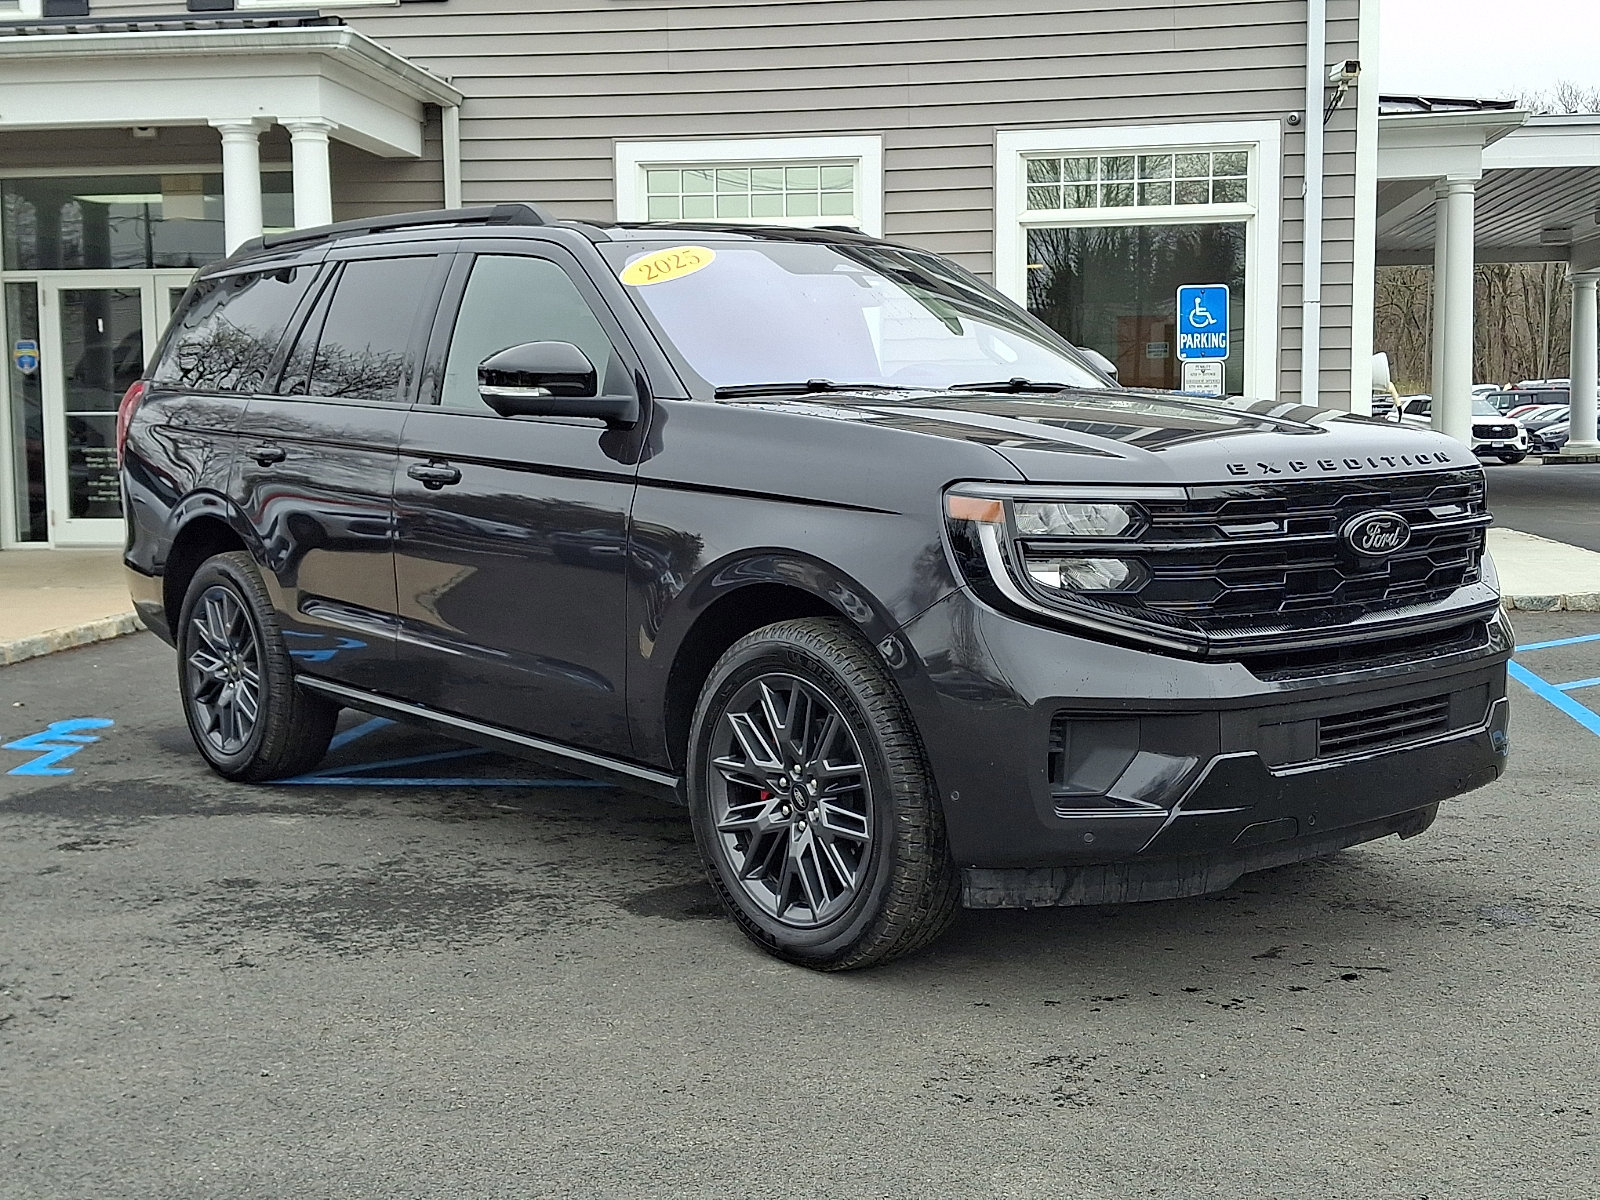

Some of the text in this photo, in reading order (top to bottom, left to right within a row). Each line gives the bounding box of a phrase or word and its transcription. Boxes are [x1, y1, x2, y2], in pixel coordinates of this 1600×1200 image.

[639, 250, 700, 280] 2025
[1180, 333, 1226, 349] PARKING
[1226, 451, 1452, 476] EXPEDITION
[1362, 521, 1401, 549] Ford
